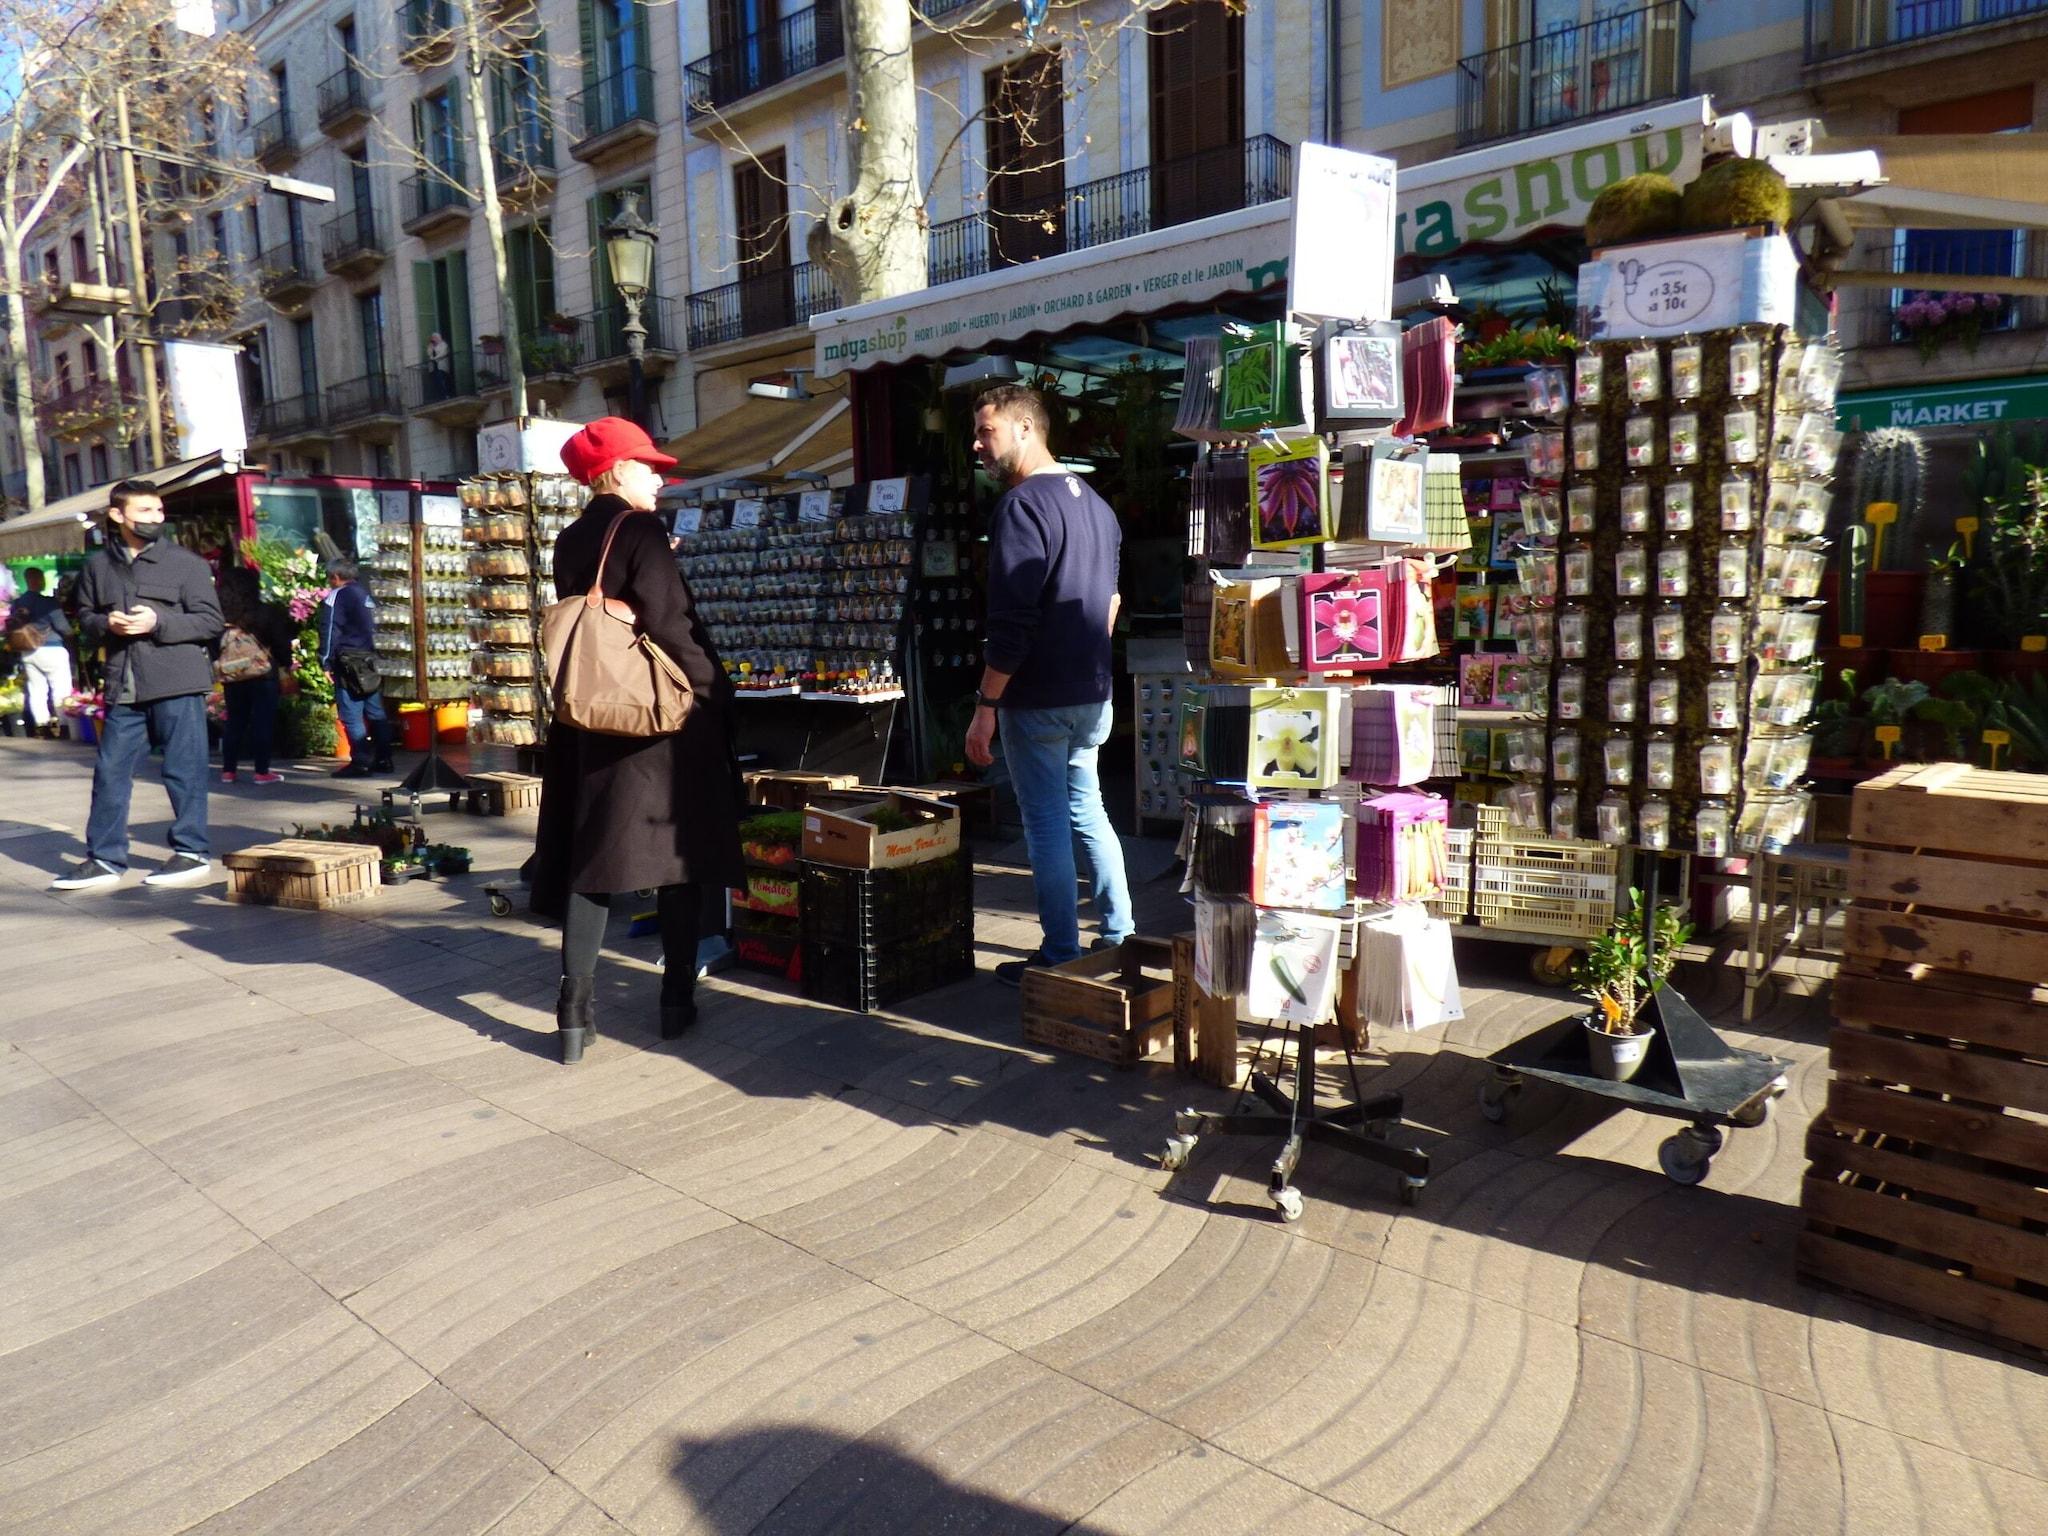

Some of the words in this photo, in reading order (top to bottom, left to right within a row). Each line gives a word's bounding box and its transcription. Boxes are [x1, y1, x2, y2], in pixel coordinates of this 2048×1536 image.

[915, 326, 934, 341] HORT
[969, 312, 1000, 330] HUERTO
[1044, 293, 1084, 314] ORCHARD
[1087, 291, 1093, 305] &
[1096, 283, 1132, 304] GARDEN
[1143, 272, 1179, 293] VERGER
[1181, 271, 1193, 285] et
[1195, 270, 1204, 282] le
[1207, 258, 1243, 280] JARDIN
[824, 327, 907, 362] moyashop
[1891, 400, 1912, 409] THE
[1891, 400, 2008, 426] MARKET
